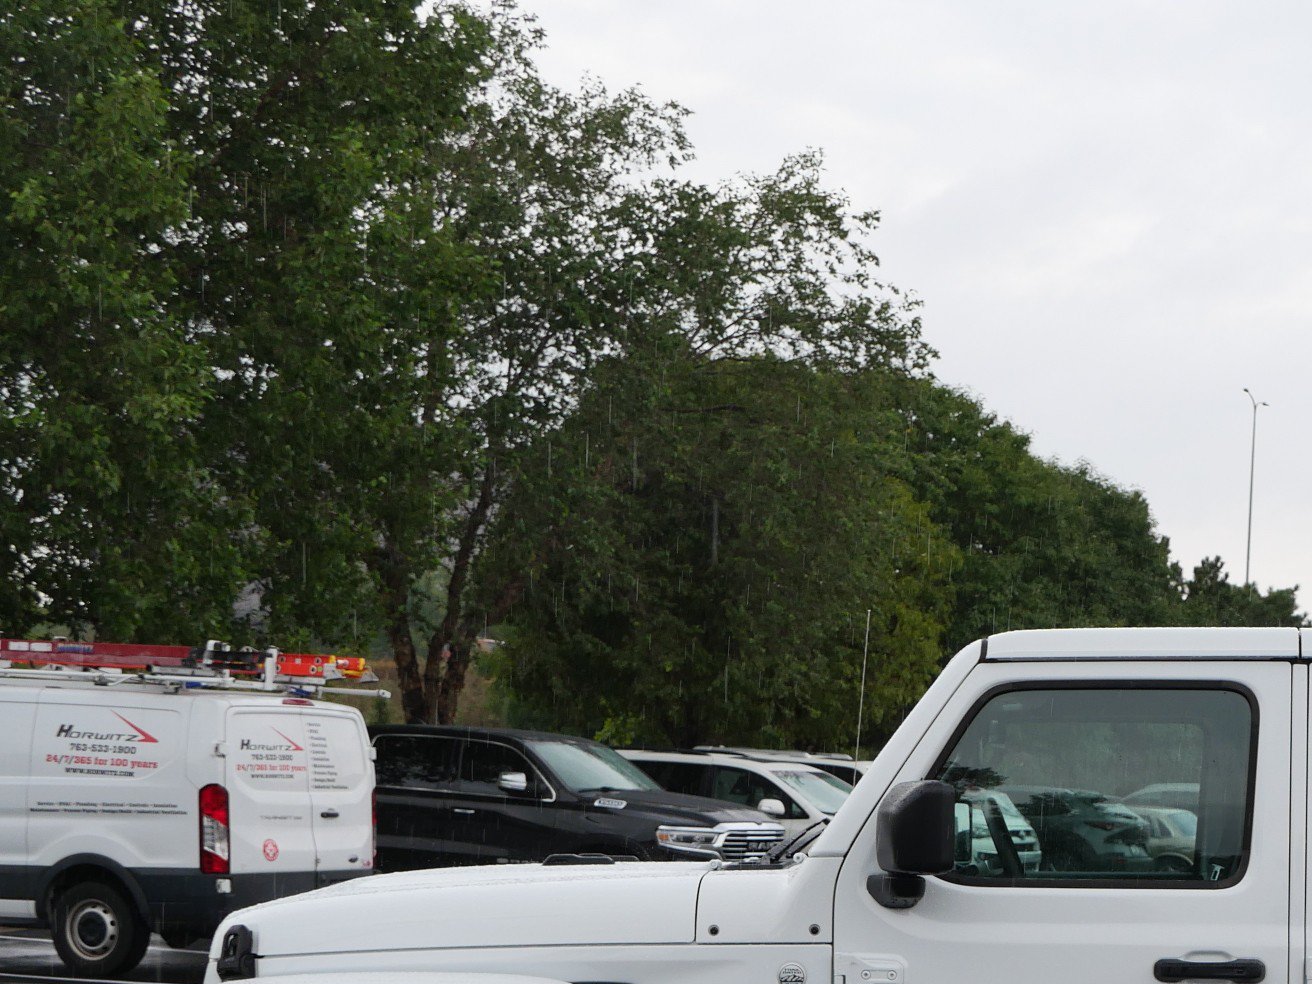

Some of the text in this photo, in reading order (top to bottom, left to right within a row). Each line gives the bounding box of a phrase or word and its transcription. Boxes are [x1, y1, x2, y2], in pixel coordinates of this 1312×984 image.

[56, 724, 139, 742] HORWITZ
[94, 757, 108, 765] for
[110, 758, 128, 766] 100
[130, 760, 158, 769] years
